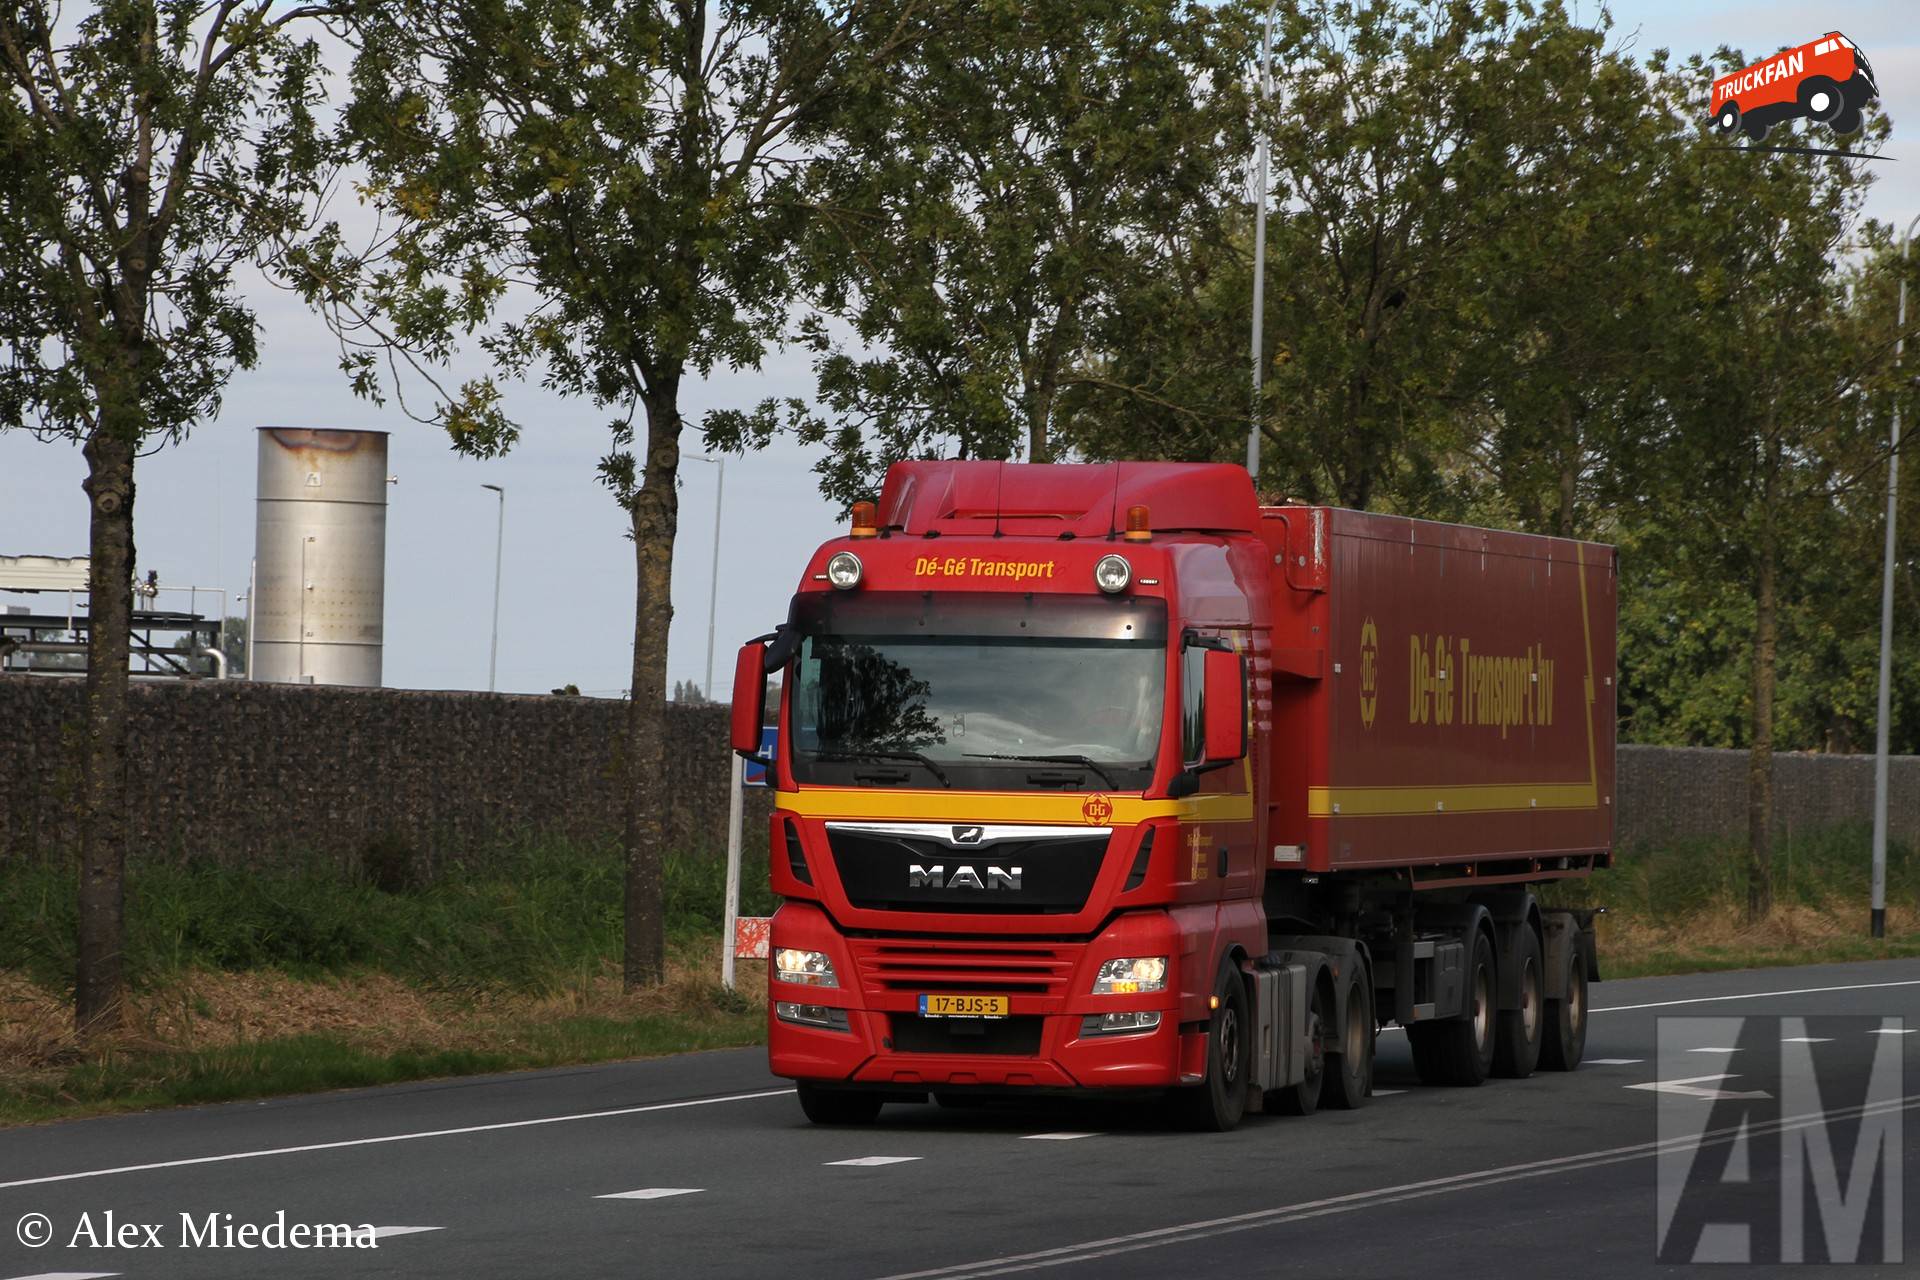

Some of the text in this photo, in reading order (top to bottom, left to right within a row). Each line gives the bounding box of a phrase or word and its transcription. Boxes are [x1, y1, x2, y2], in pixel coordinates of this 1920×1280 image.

[915, 556, 1054, 581] Dé-Gé Transport
[1409, 632, 1454, 726] Dé-Gé
[1460, 638, 1534, 740] Transport
[909, 864, 1022, 890] MAN
[935, 997, 999, 1012] 17-BJS-5
